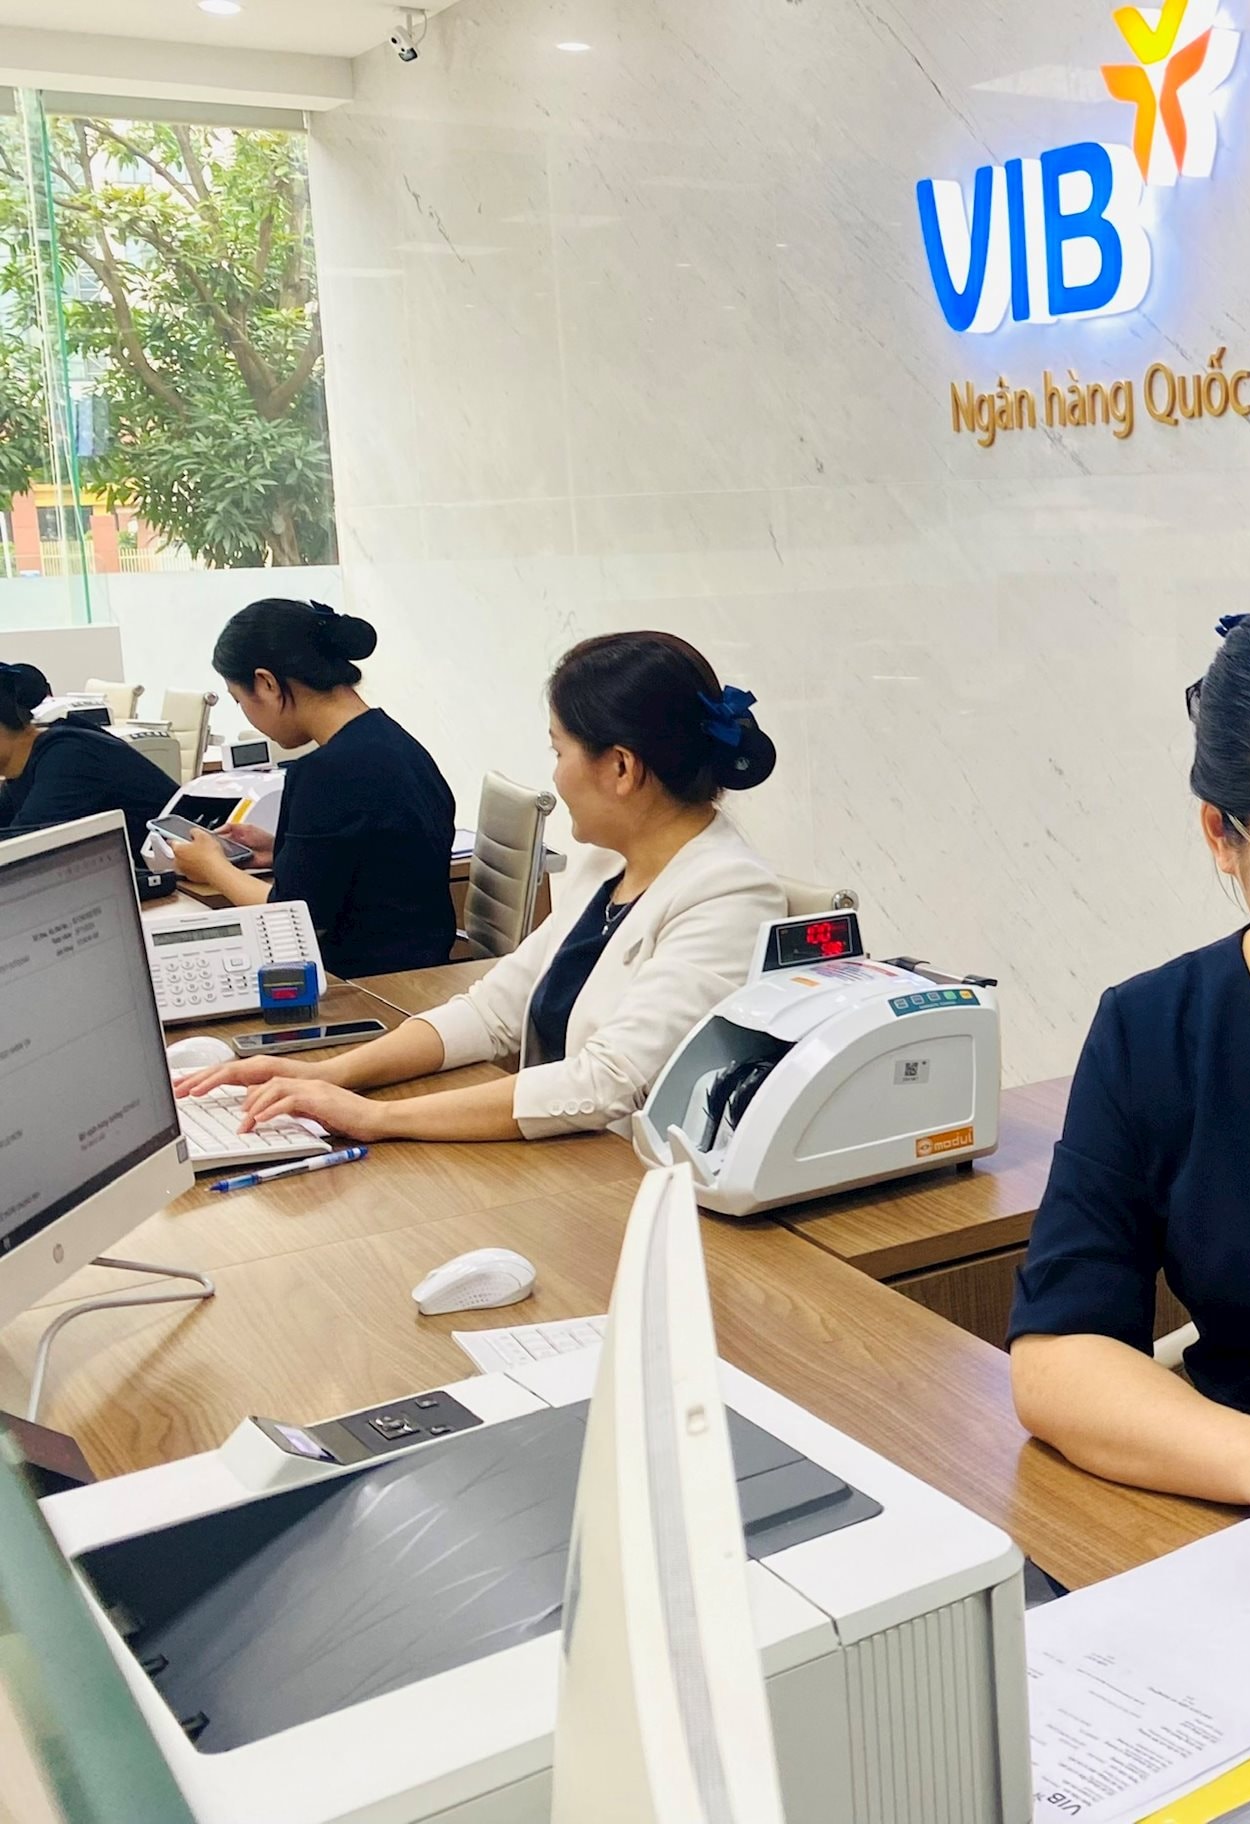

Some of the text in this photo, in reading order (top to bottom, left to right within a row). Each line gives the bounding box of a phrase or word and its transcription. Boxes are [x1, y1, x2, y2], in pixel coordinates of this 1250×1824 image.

[916, 141, 1124, 333] VIB
[950, 377, 1036, 447] Ngân
[1043, 368, 1135, 440] hàng
[1047, 1792, 1081, 1816] VIB
